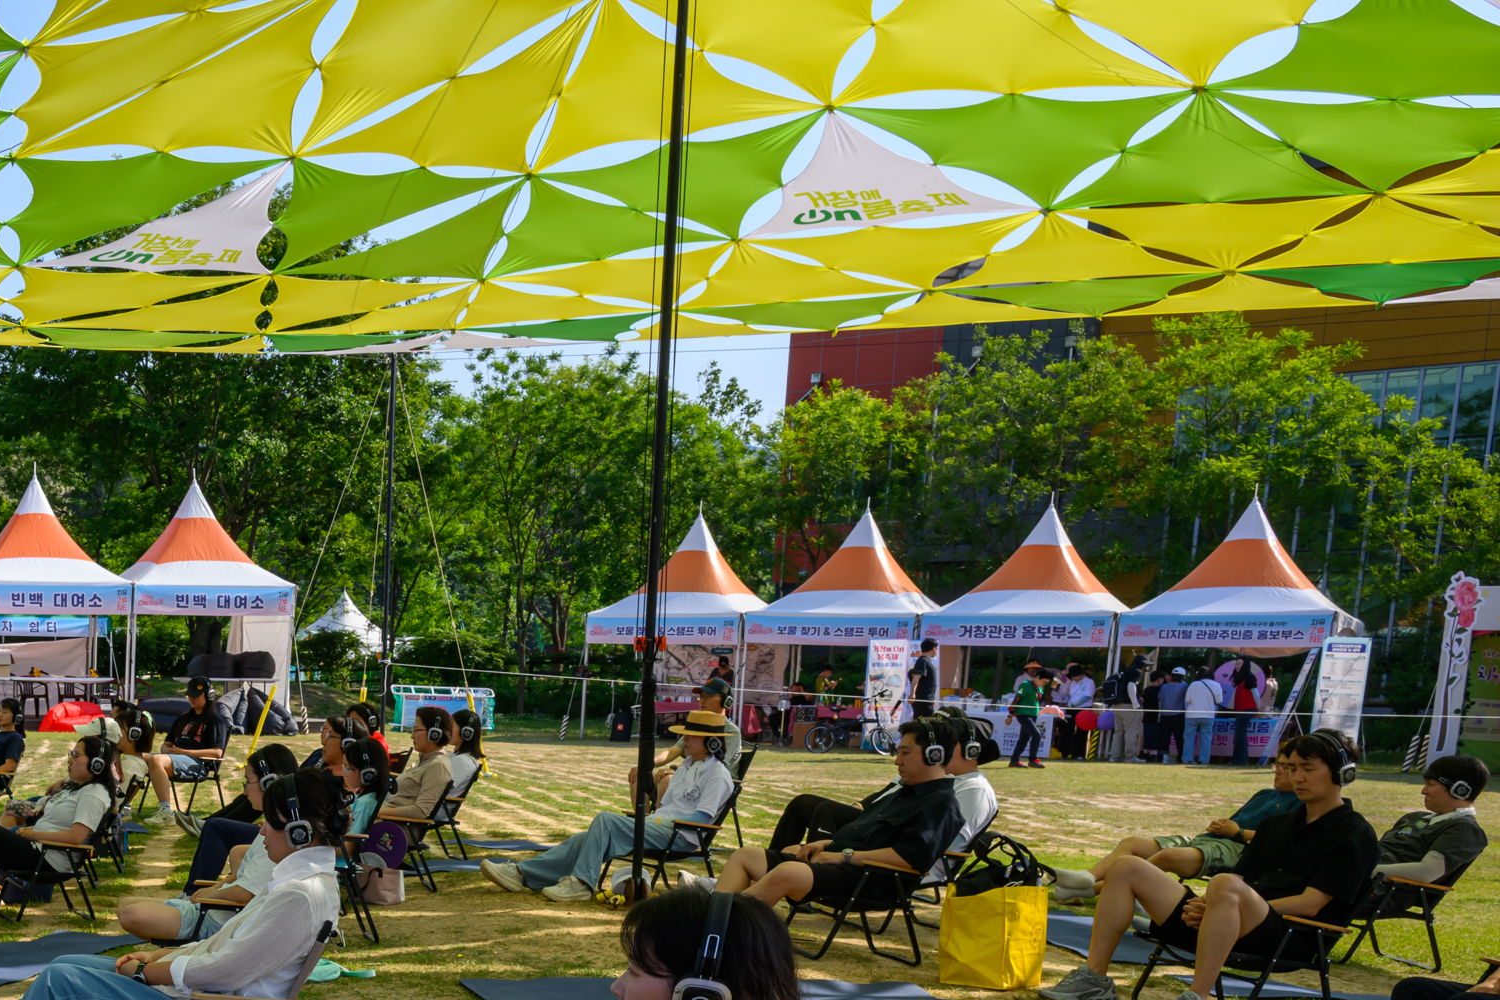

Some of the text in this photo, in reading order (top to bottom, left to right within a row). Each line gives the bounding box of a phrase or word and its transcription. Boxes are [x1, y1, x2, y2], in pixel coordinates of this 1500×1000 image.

[794, 189, 882, 208] 거창에
[130, 233, 201, 252] 거창에
[11, 592, 102, 608] 빈백 대여소
[175, 594, 264, 609] 빈백 대여소
[28, 620, 57, 633] 쉼터
[616, 626, 634, 636] 보물
[667, 626, 694, 636] 스탬프
[698, 626, 716, 636] 투어
[777, 625, 889, 637] 보물 찾기 & 스탬프 투어
[959, 625, 1082, 639] 거창관광 홍보부스
[1159, 629, 1305, 640] 디지털 관광주민증 홍보부스
